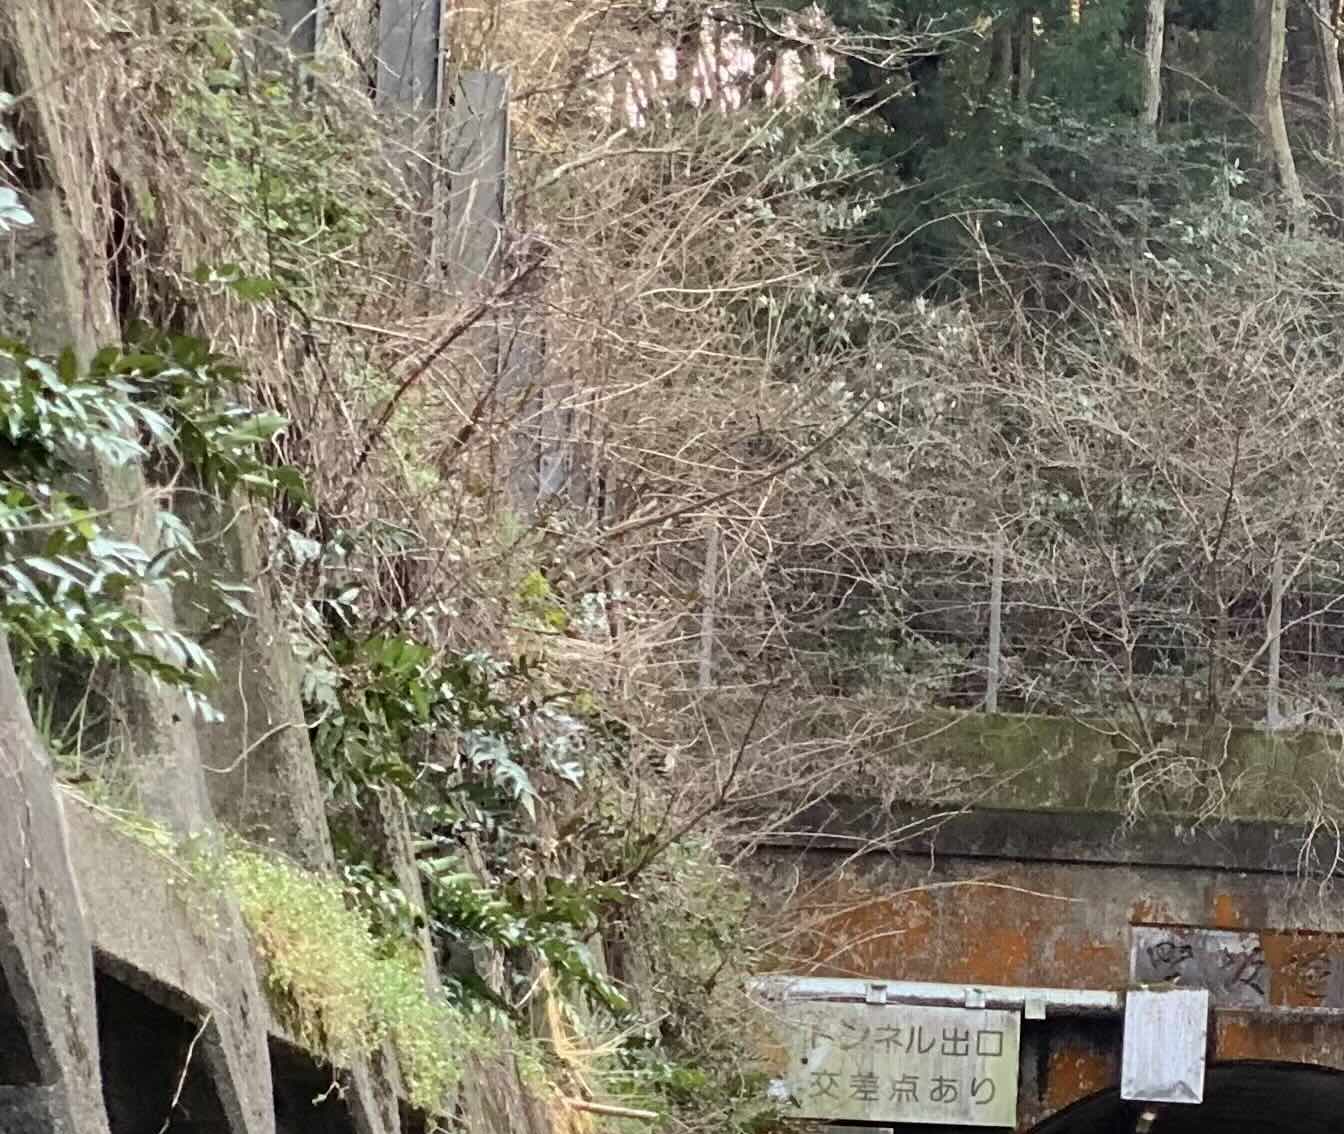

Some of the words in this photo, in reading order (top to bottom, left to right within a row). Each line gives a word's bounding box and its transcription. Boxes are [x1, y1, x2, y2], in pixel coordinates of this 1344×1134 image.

[810, 1019, 1004, 1056] トンネル出口
[808, 1070, 996, 1105] 交差点あり
